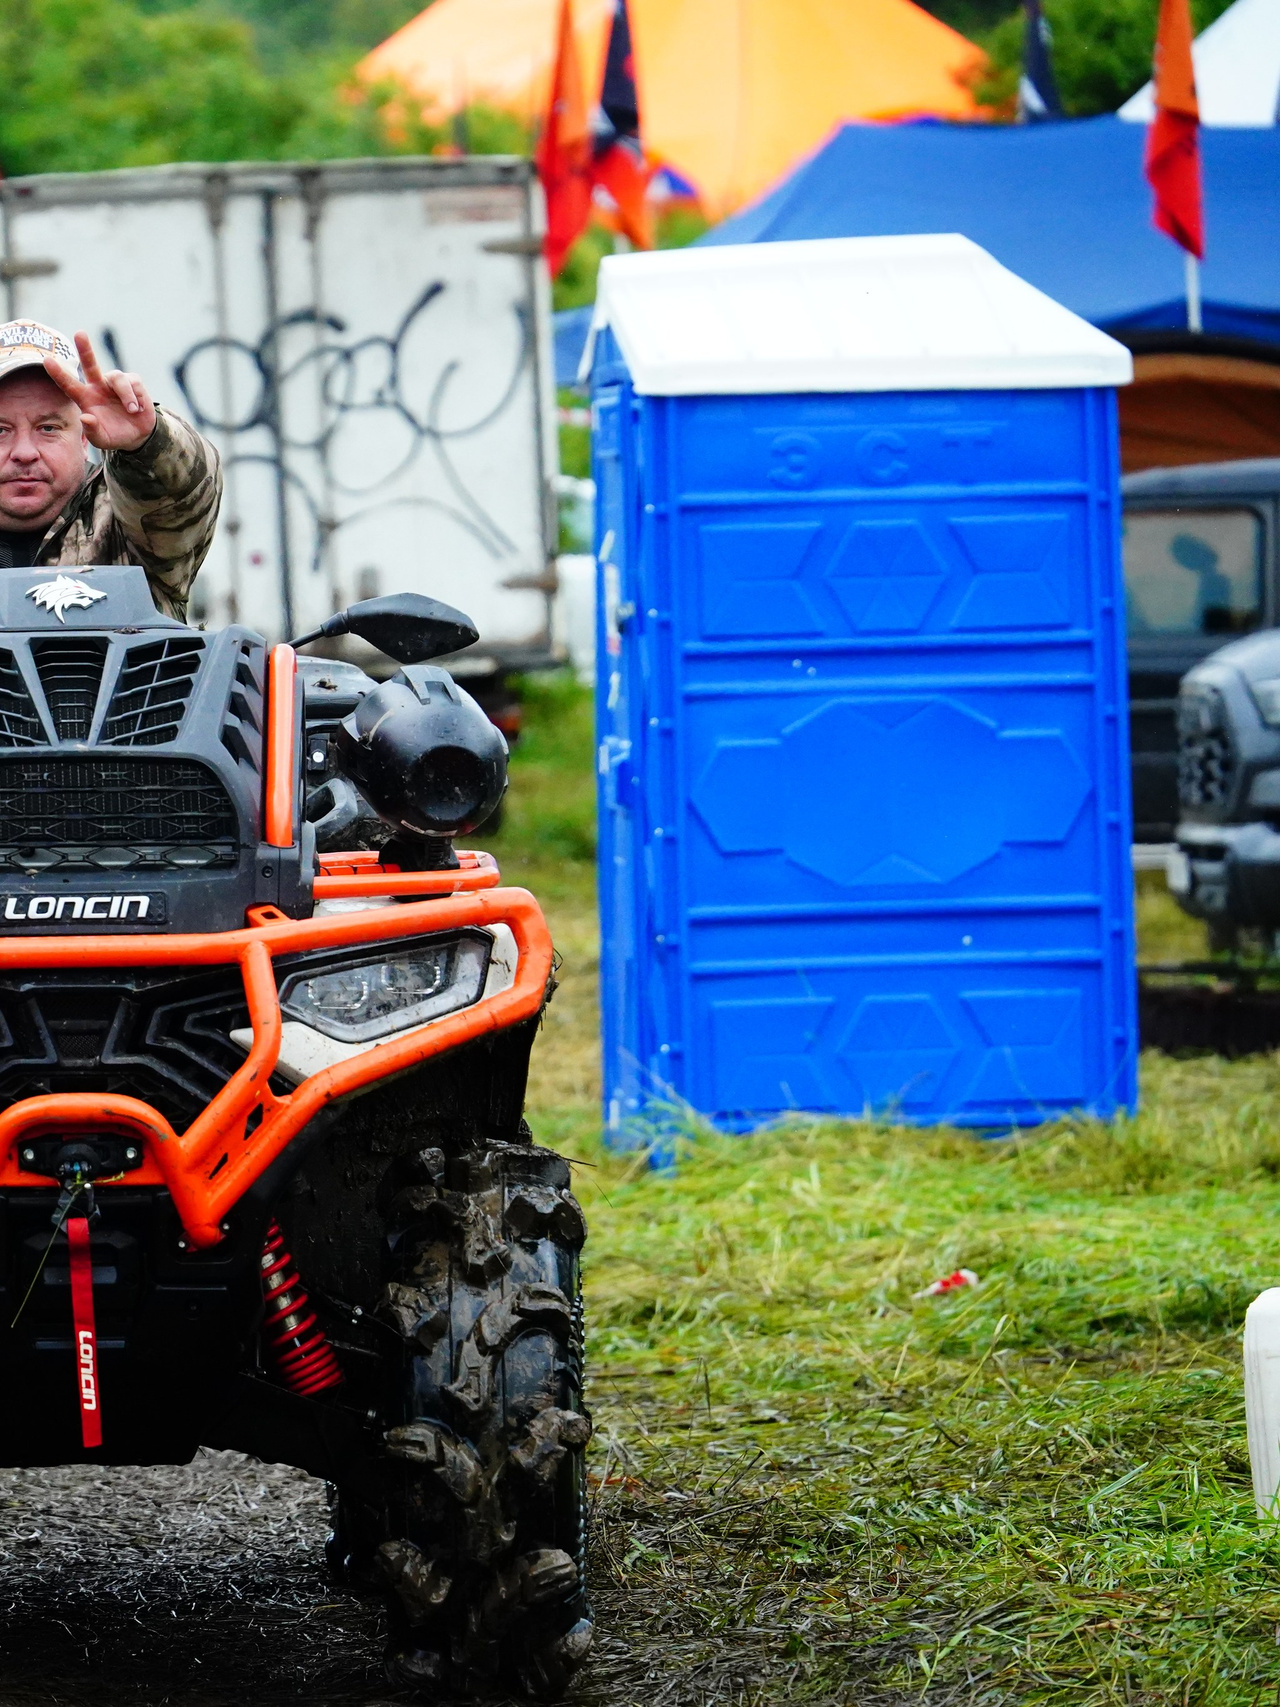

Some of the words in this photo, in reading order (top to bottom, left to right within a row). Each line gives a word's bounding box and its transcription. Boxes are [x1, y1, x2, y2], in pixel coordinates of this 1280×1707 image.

[2, 333, 50, 349] MOTORS
[24, 325, 54, 344] FANG
[4, 895, 151, 920] LONCIN
[78, 1330, 97, 1411] LONCIN
